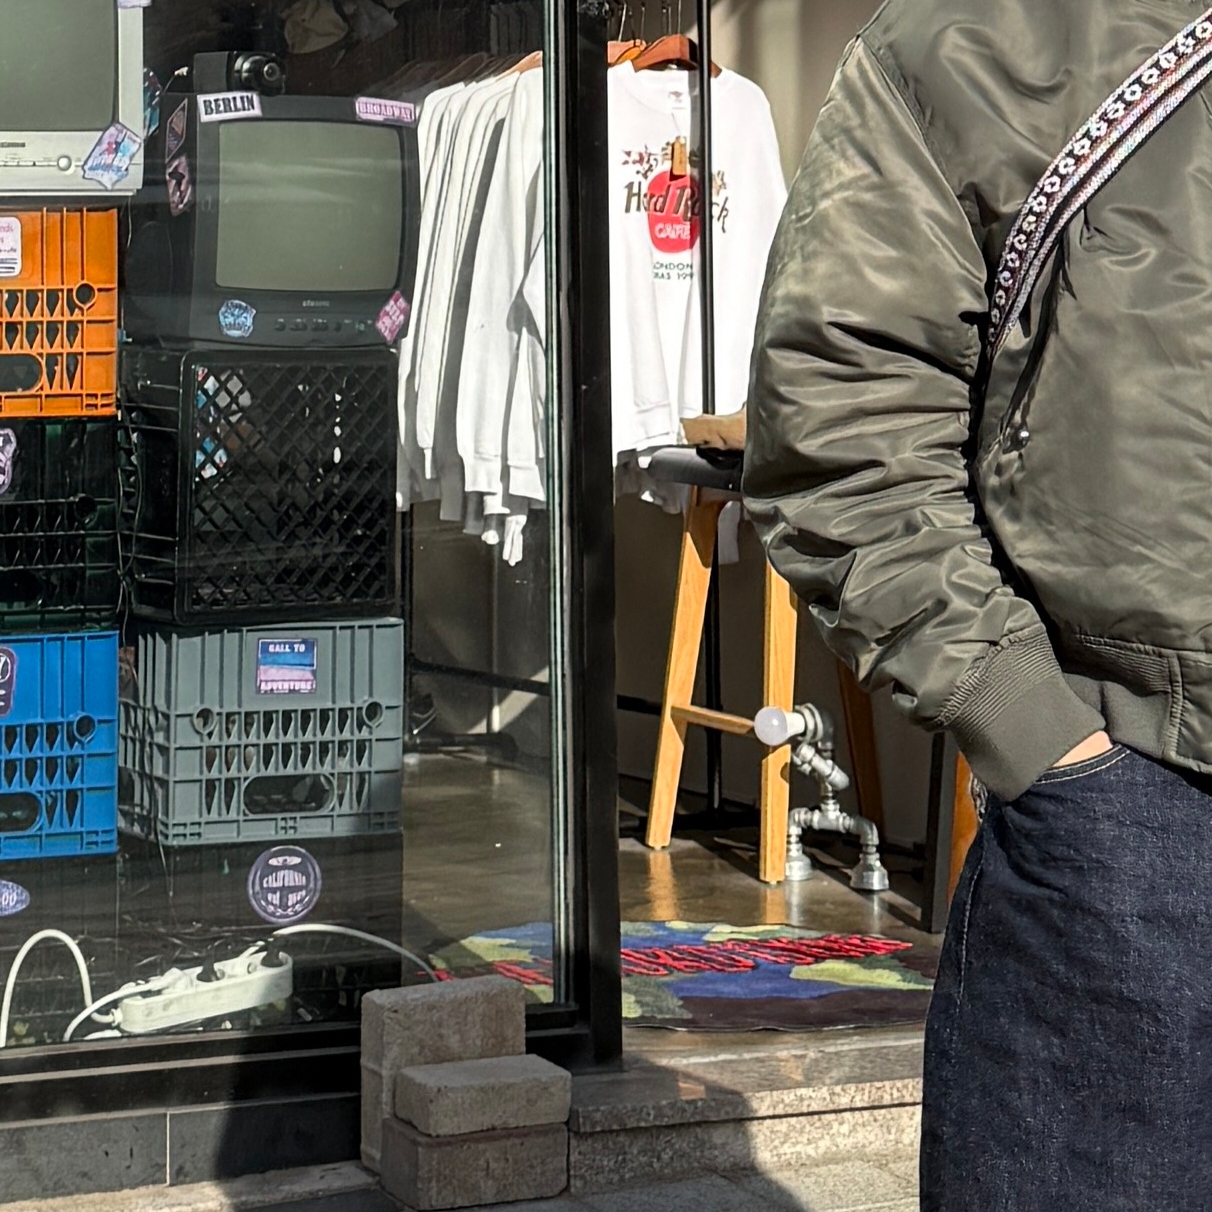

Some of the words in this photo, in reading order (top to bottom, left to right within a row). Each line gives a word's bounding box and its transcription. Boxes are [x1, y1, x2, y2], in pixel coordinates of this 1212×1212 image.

[203, 94, 255, 116] BERLIN
[268, 644, 291, 653] CALL
[293, 643, 306, 653] TO
[260, 680, 312, 690] ADVENTURE
